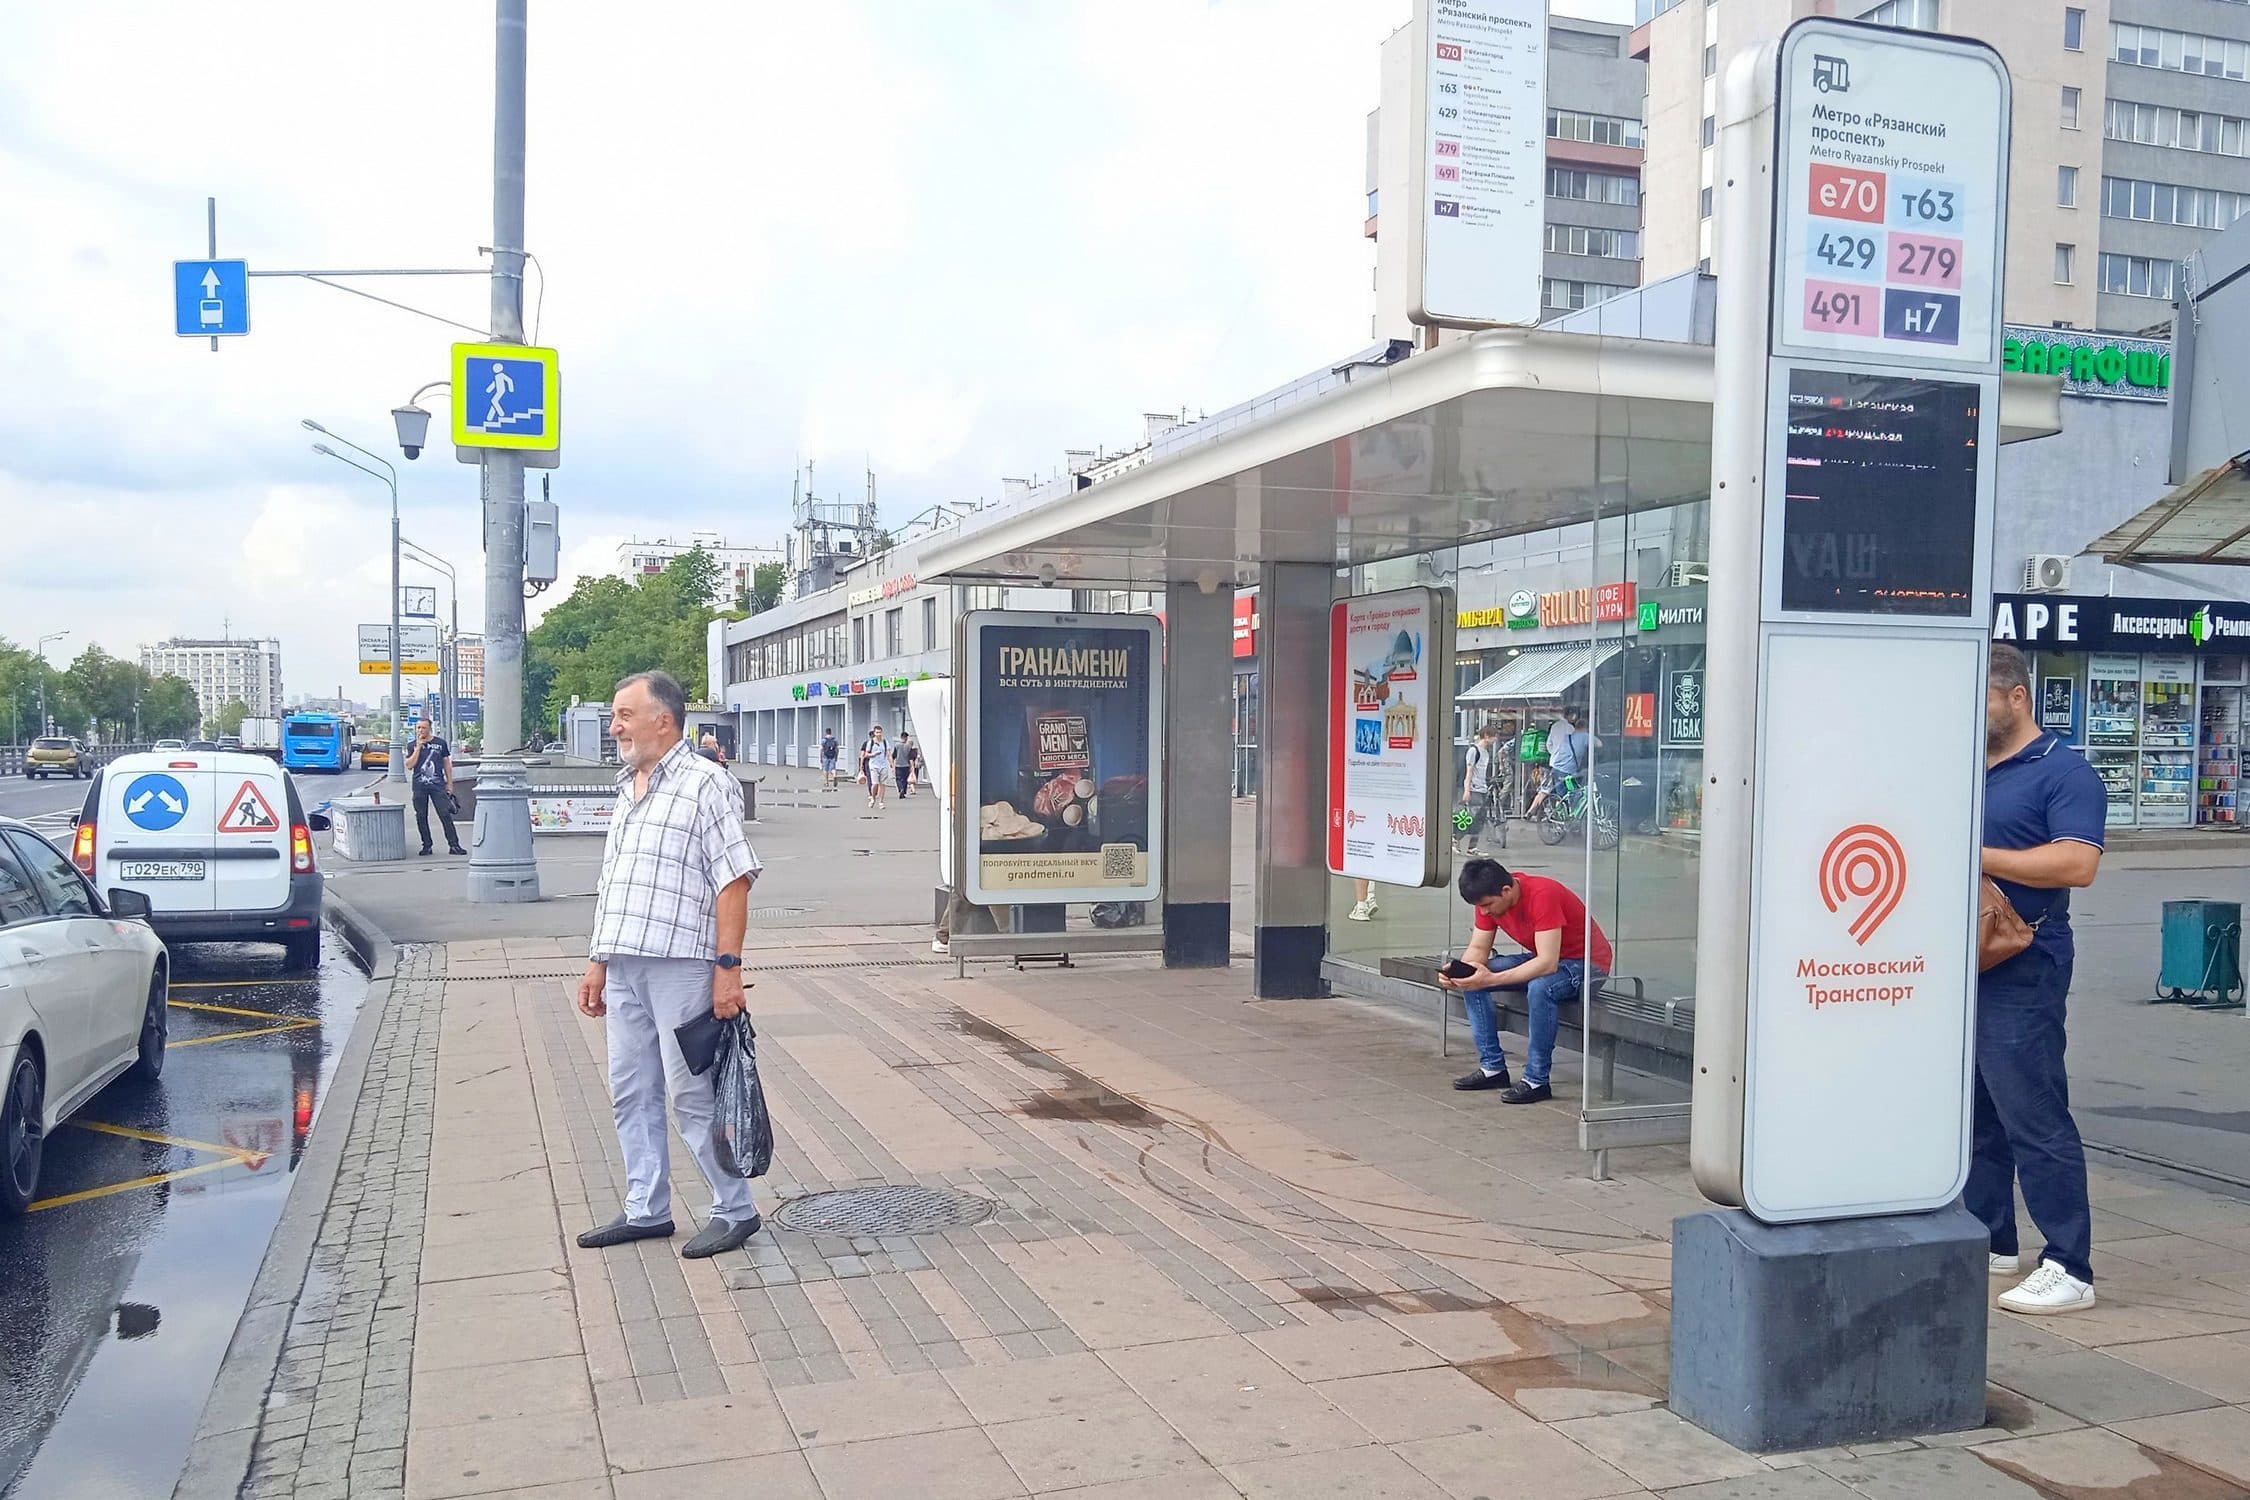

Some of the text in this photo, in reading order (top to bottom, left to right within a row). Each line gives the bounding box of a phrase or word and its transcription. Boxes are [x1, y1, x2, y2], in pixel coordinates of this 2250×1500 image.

[1438, 7, 1532, 29] «Рязанский проспект»
[1439, 47, 1459, 58] е70
[1439, 83, 1457, 94] т63
[1438, 107, 1458, 119] 429
[1812, 103, 1947, 138] Метро «Рязанский
[1811, 126, 1886, 148] проспект»
[1438, 143, 1457, 155] 279
[1809, 144, 1945, 175] Metro Ryazanskiy Prospekt
[1439, 168, 1456, 179] 491
[1819, 176, 1955, 223] е70 т63
[1816, 232, 1957, 279] 429 279
[1810, 289, 1944, 334] 491 н7
[1596, 602, 1624, 619] АУРМ
[1658, 607, 1703, 625] МИЛТИ
[1993, 602, 2079, 642] APE
[2112, 612, 2187, 639] Аксессуары
[1000, 646, 1127, 677] ГРАНДМЕНИ
[1000, 678, 1128, 689] ВСЯ СУТЬ В ИНГРЕДИЕНТАХ!
[1626, 695, 1643, 728] 24
[2044, 711, 2070, 724] НАПИТКИ
[1039, 723, 1067, 734] GRAND
[1673, 718, 1701, 738] ТАБАК
[1040, 734, 1068, 753] MENI
[1041, 754, 1066, 762] МНОГО
[983, 858, 1098, 868] ПОПРОБУЙТЕ ИДЕАЛЬНЫЙ ВКУС
[1008, 869, 1075, 882] grandmeni.ru
[1797, 955, 1925, 978] Московский
[1805, 984, 1914, 1010] Транспорт
